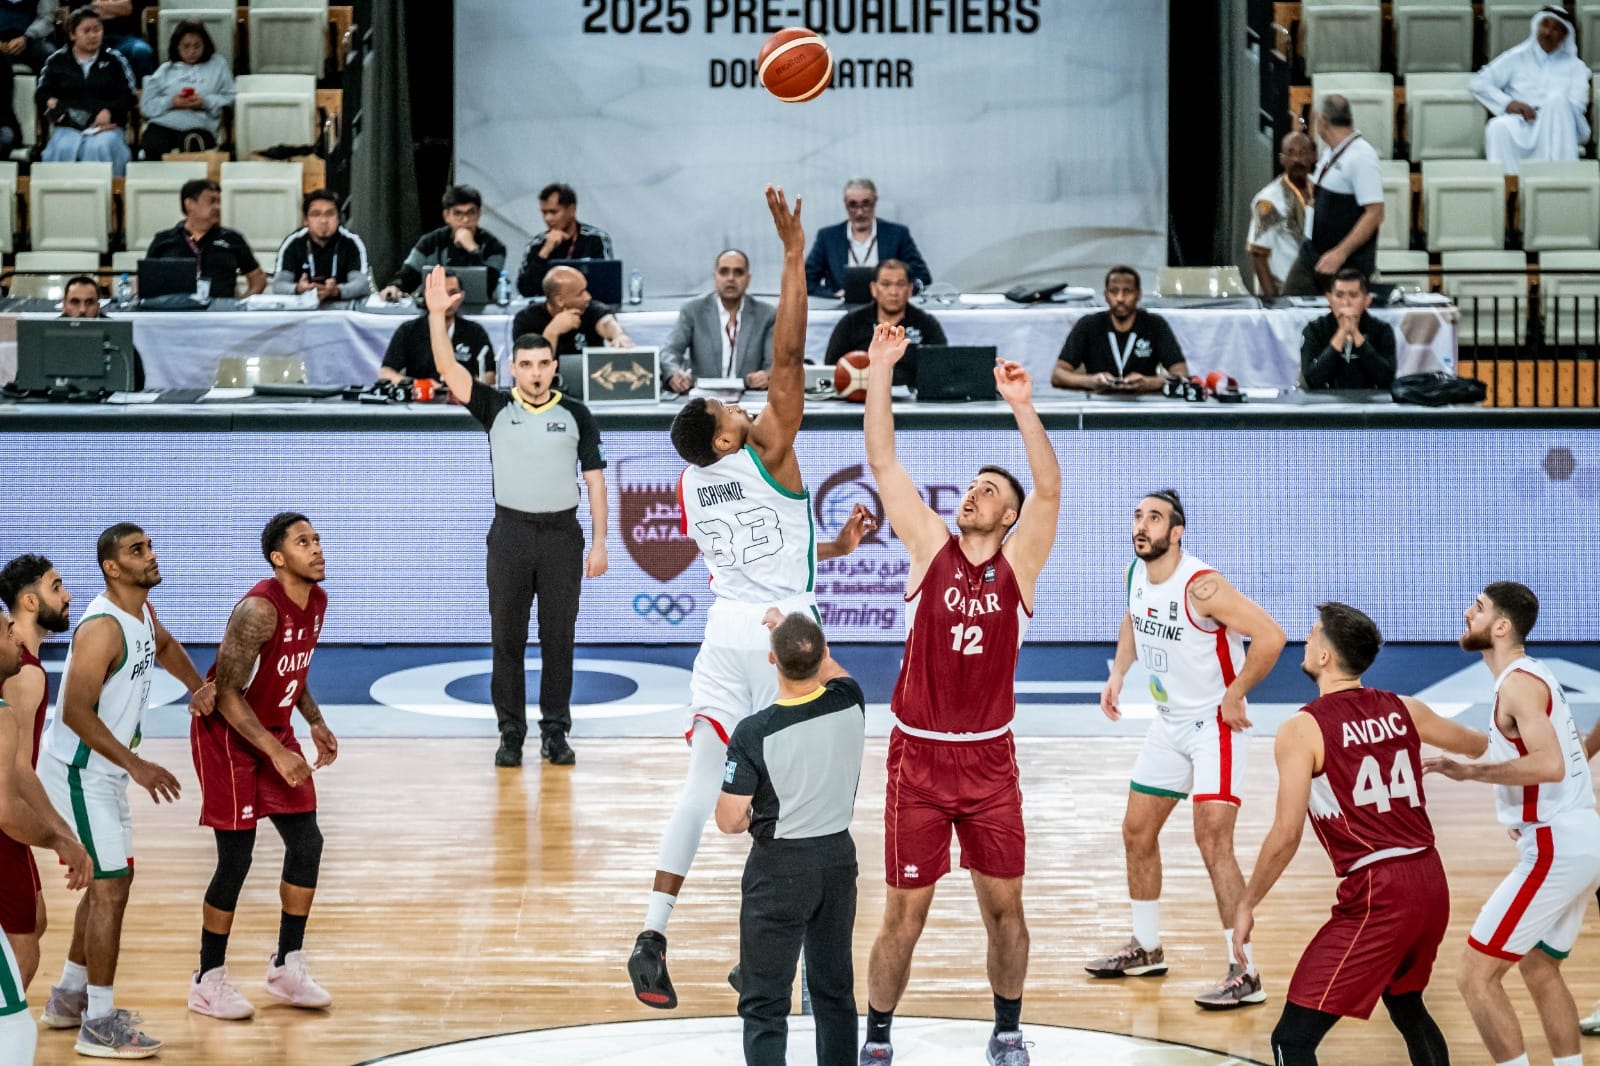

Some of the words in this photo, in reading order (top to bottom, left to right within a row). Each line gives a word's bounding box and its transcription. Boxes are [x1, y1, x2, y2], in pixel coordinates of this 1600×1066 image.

[582, 0, 690, 34] 2025
[704, 0, 1041, 36] PRE-QUALIFIERS
[632, 524, 682, 545] QATA
[695, 505, 784, 568] 33
[944, 586, 1002, 617] QATAR
[950, 622, 984, 656] 12
[1141, 643, 1169, 673] 10
[278, 679, 298, 708] 2
[1342, 711, 1408, 748] AVDIC
[1352, 748, 1421, 814] 44
